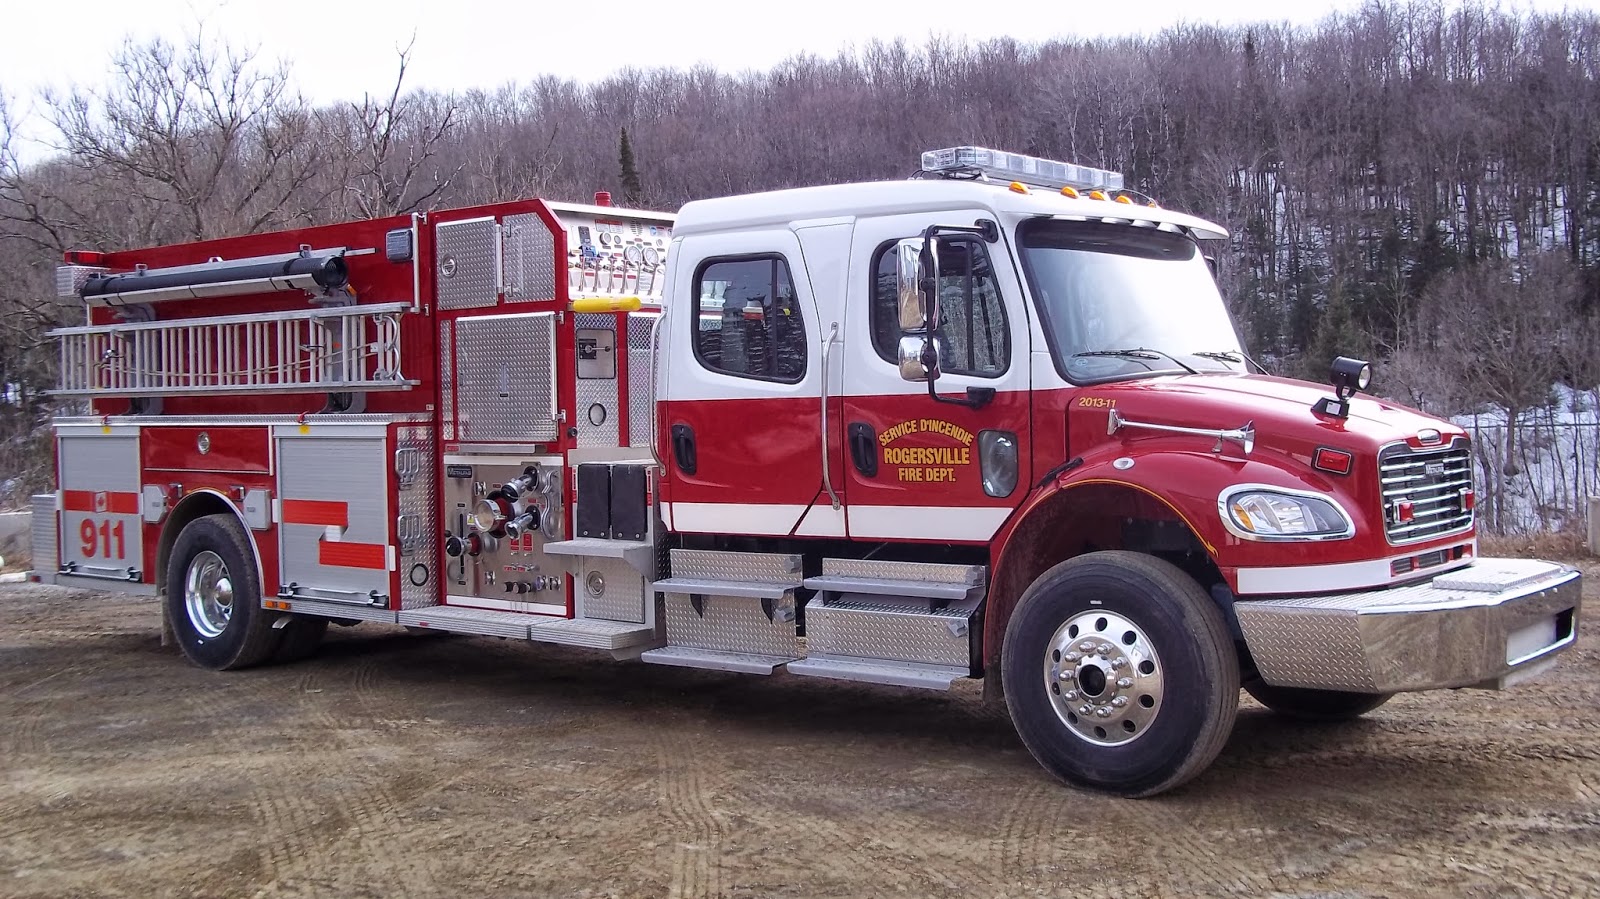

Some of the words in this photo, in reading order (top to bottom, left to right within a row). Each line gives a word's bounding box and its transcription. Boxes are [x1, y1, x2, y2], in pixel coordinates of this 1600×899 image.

[1079, 397, 1116, 408] 2013-11
[879, 420, 918, 447] SERVICE
[920, 418, 974, 447] D'INCENDIE
[883, 447, 970, 465] ROGERSVILLE
[899, 467, 923, 482] FIRE
[925, 467, 956, 482] DEPT.
[80, 518, 126, 560] 911
